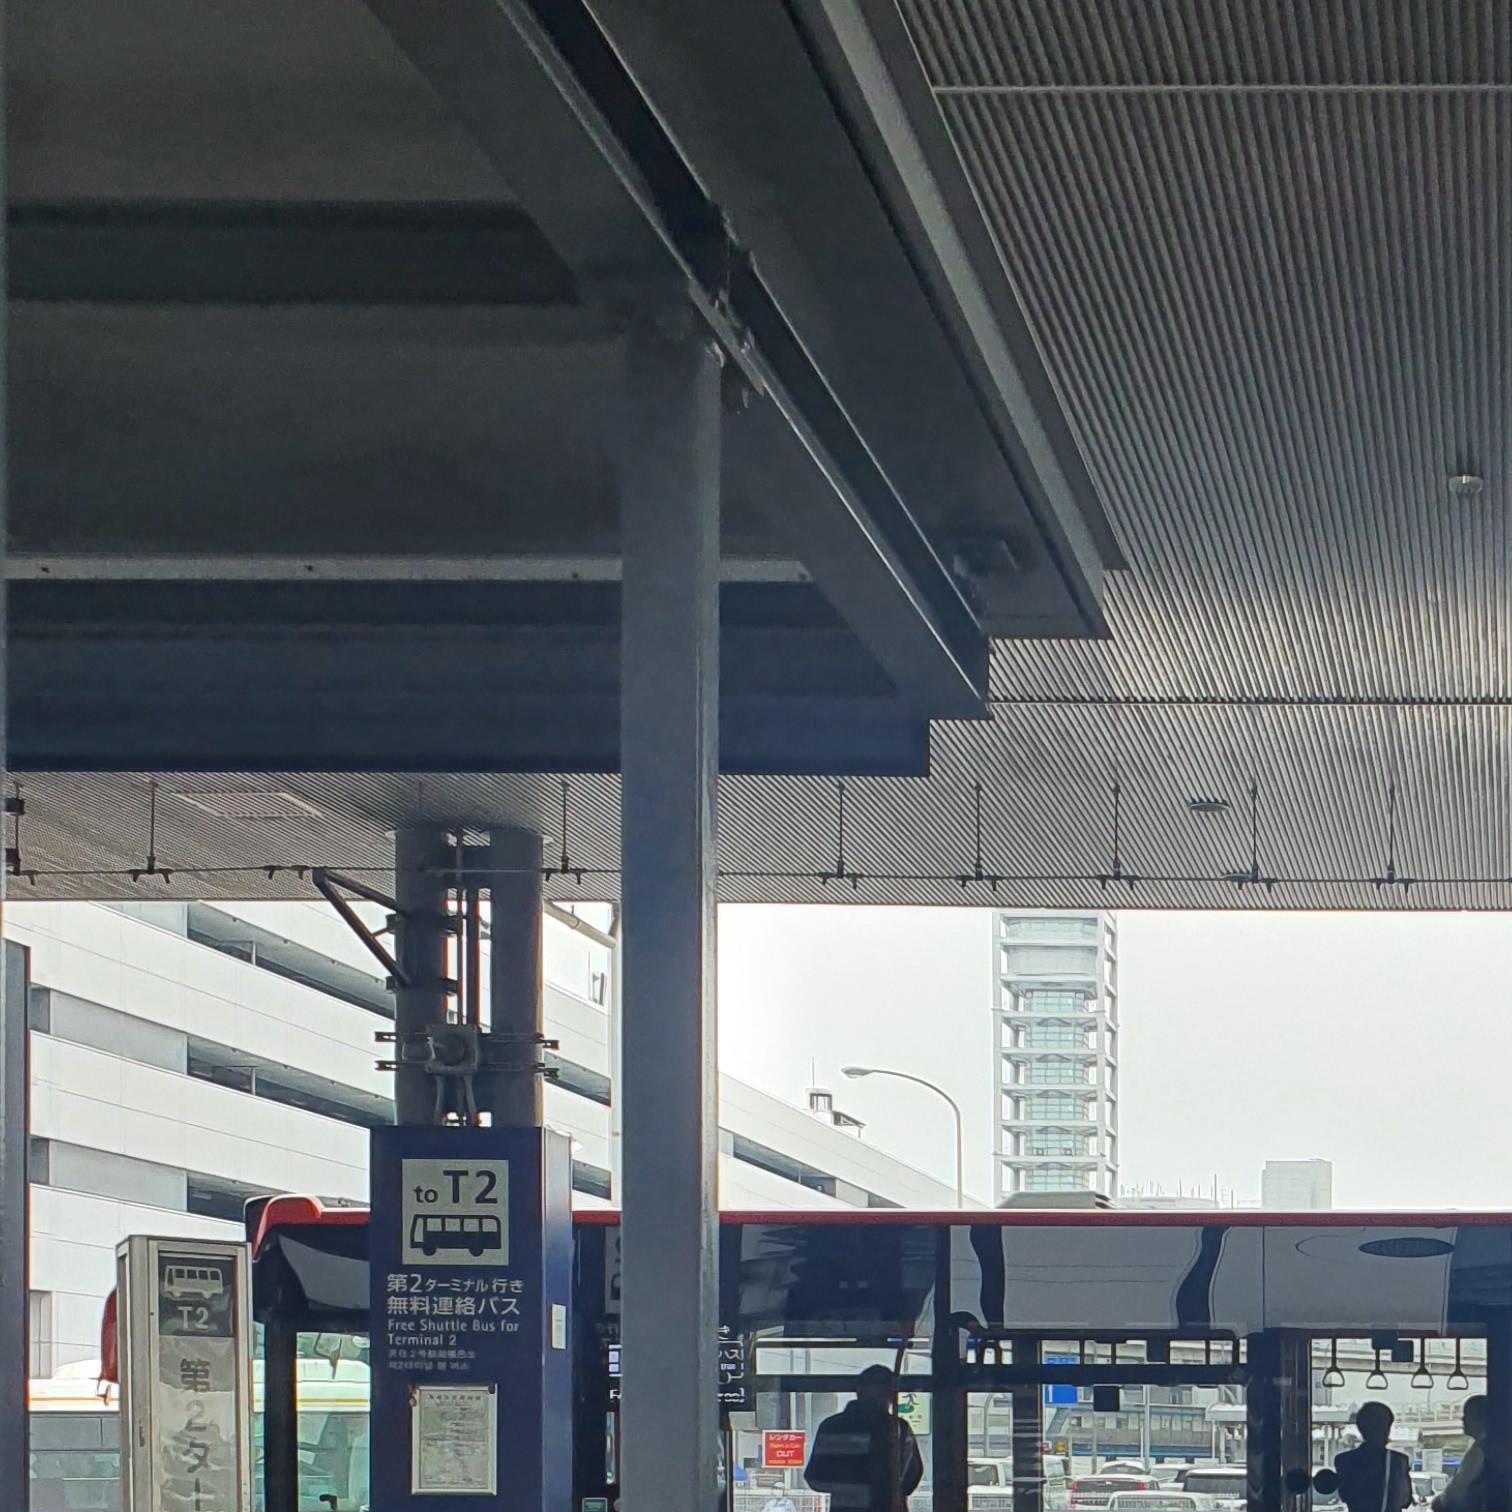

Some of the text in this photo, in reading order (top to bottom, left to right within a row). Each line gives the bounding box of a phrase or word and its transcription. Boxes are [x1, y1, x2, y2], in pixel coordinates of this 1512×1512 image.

[414, 1169, 498, 1204] to T2
[387, 1295, 520, 1315] 無料連絡バス
[177, 1306, 210, 1330] T2
[387, 1319, 520, 1331] Free Shuttle Bus for
[387, 1333, 457, 1346] Terminal 2
